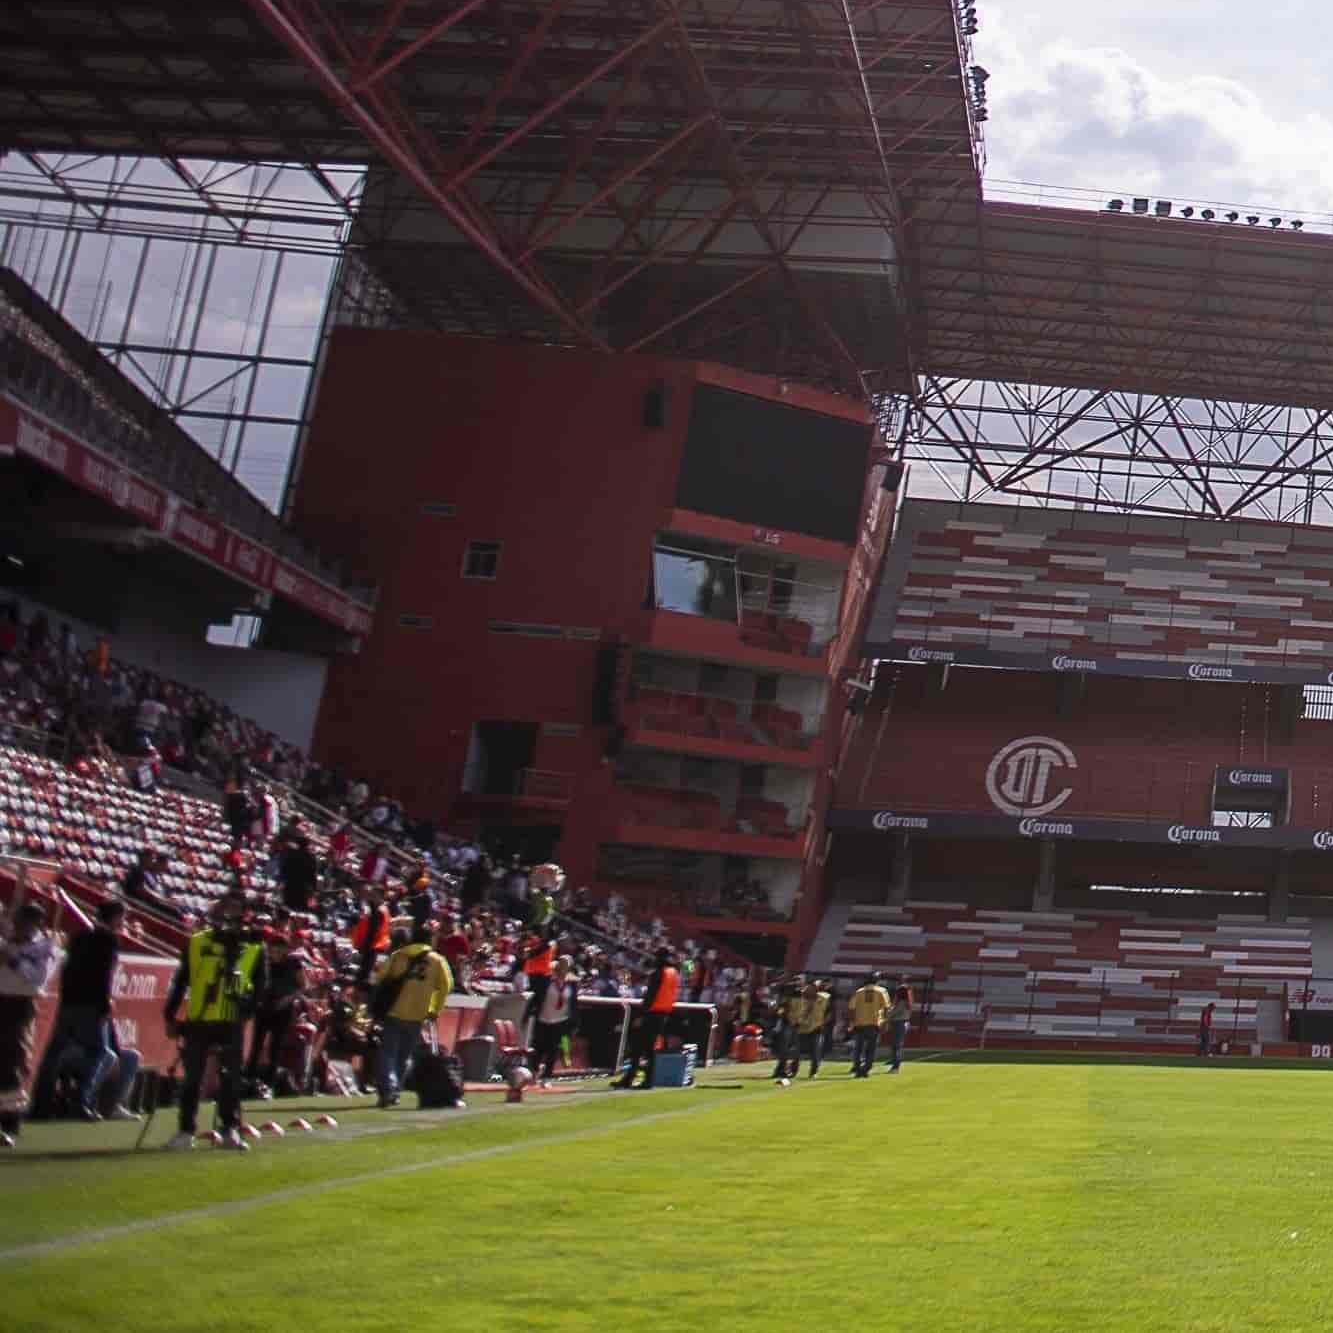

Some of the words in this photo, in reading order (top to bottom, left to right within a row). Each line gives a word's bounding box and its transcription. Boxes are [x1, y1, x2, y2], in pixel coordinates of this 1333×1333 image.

[1052, 655, 1097, 671] Corona
[1188, 664, 1233, 680] Corona
[1228, 769, 1272, 785] Corona
[872, 811, 928, 830] Corona
[1019, 817, 1073, 837] Corona
[1167, 824, 1220, 843] Corona
